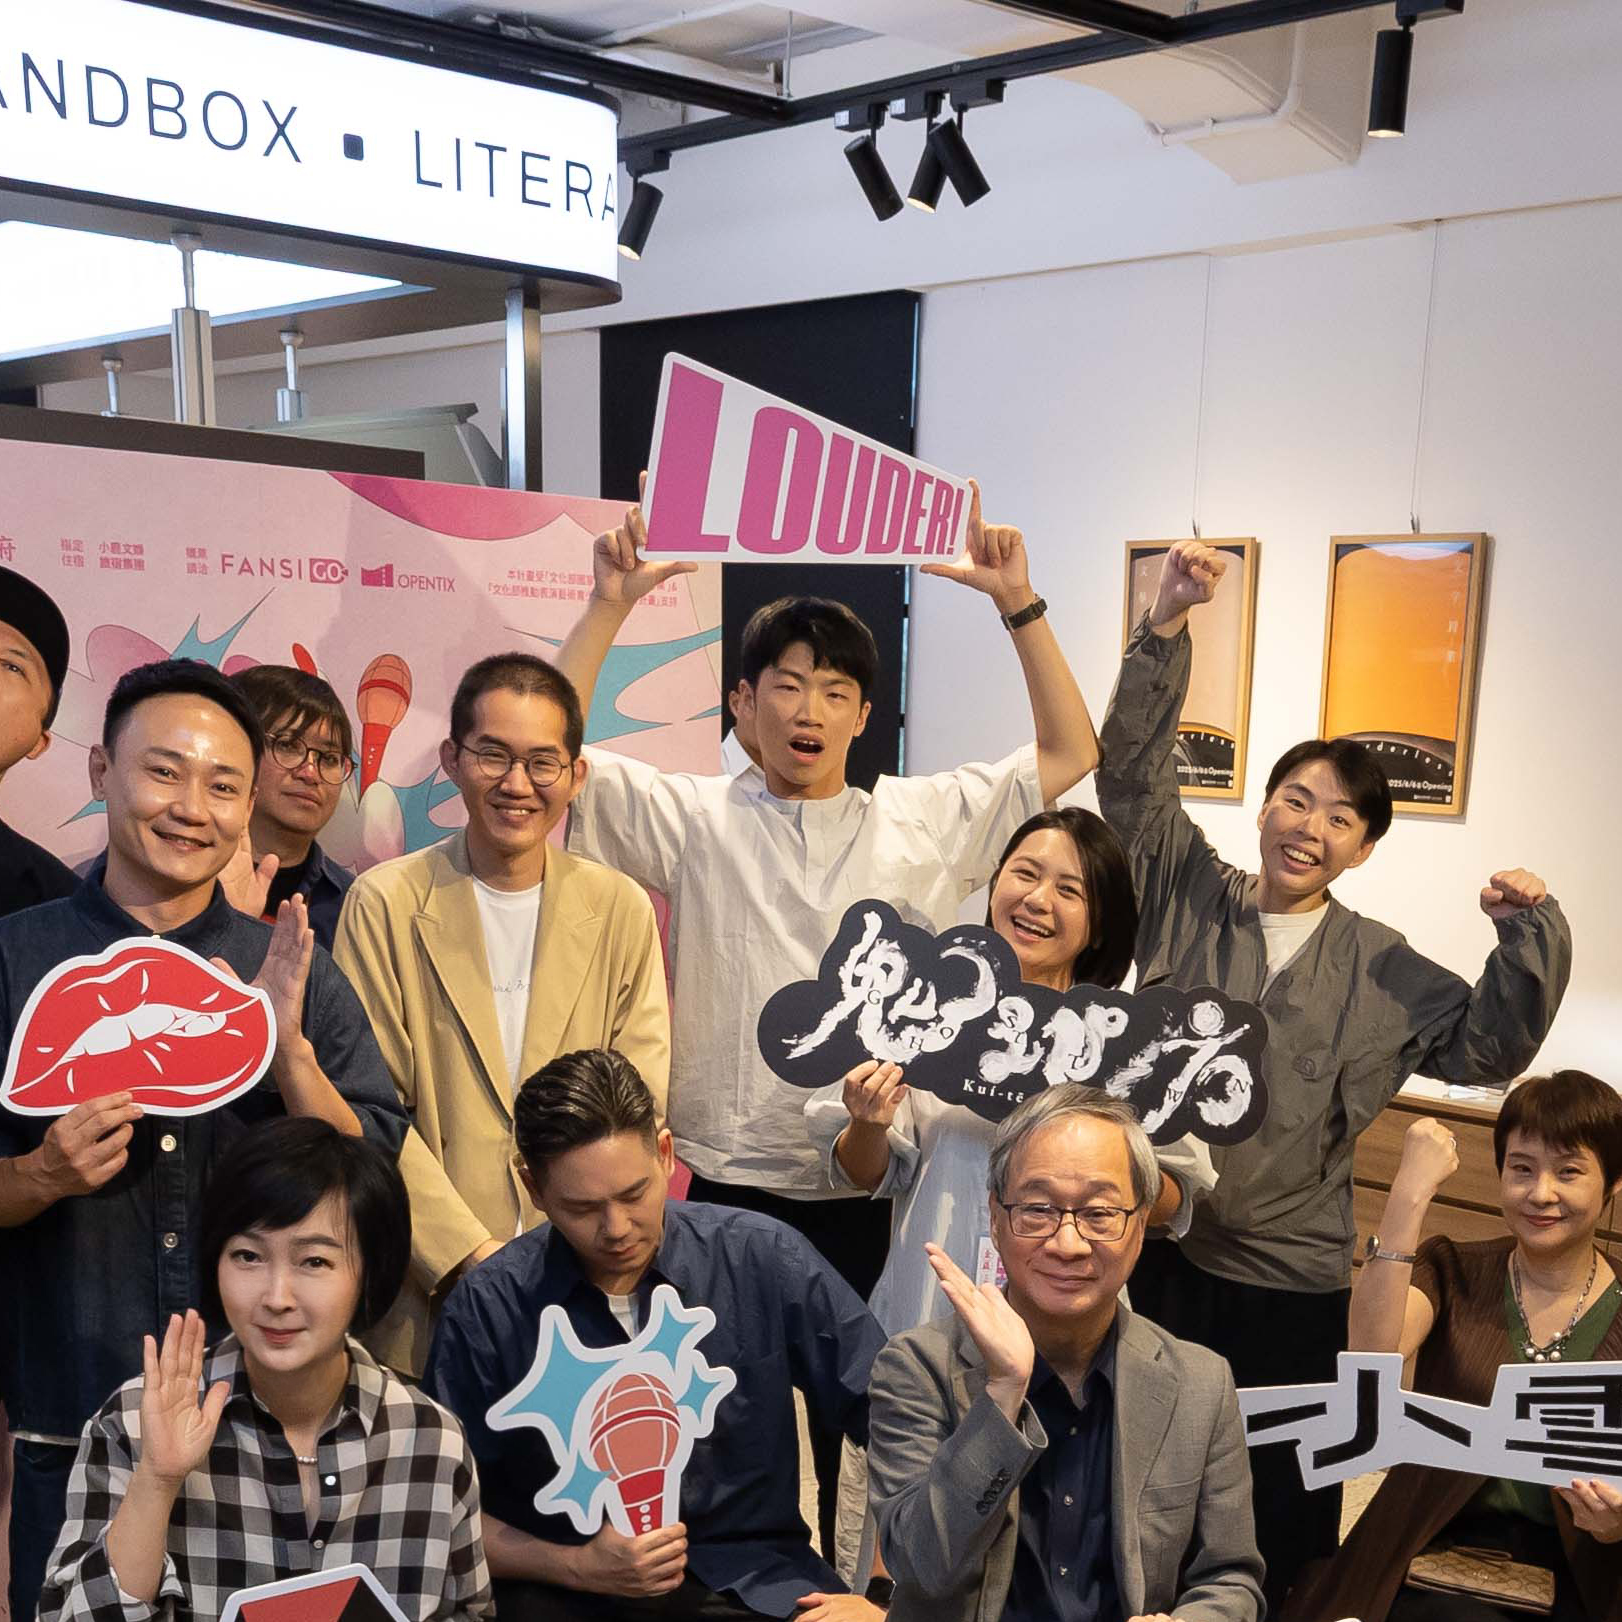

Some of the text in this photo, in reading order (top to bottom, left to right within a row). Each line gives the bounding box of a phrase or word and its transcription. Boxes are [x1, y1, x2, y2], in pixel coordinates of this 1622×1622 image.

[644, 360, 965, 556] LOUDER!
[221, 554, 344, 580] FANSI GO
[397, 573, 456, 593] OPENTIX
